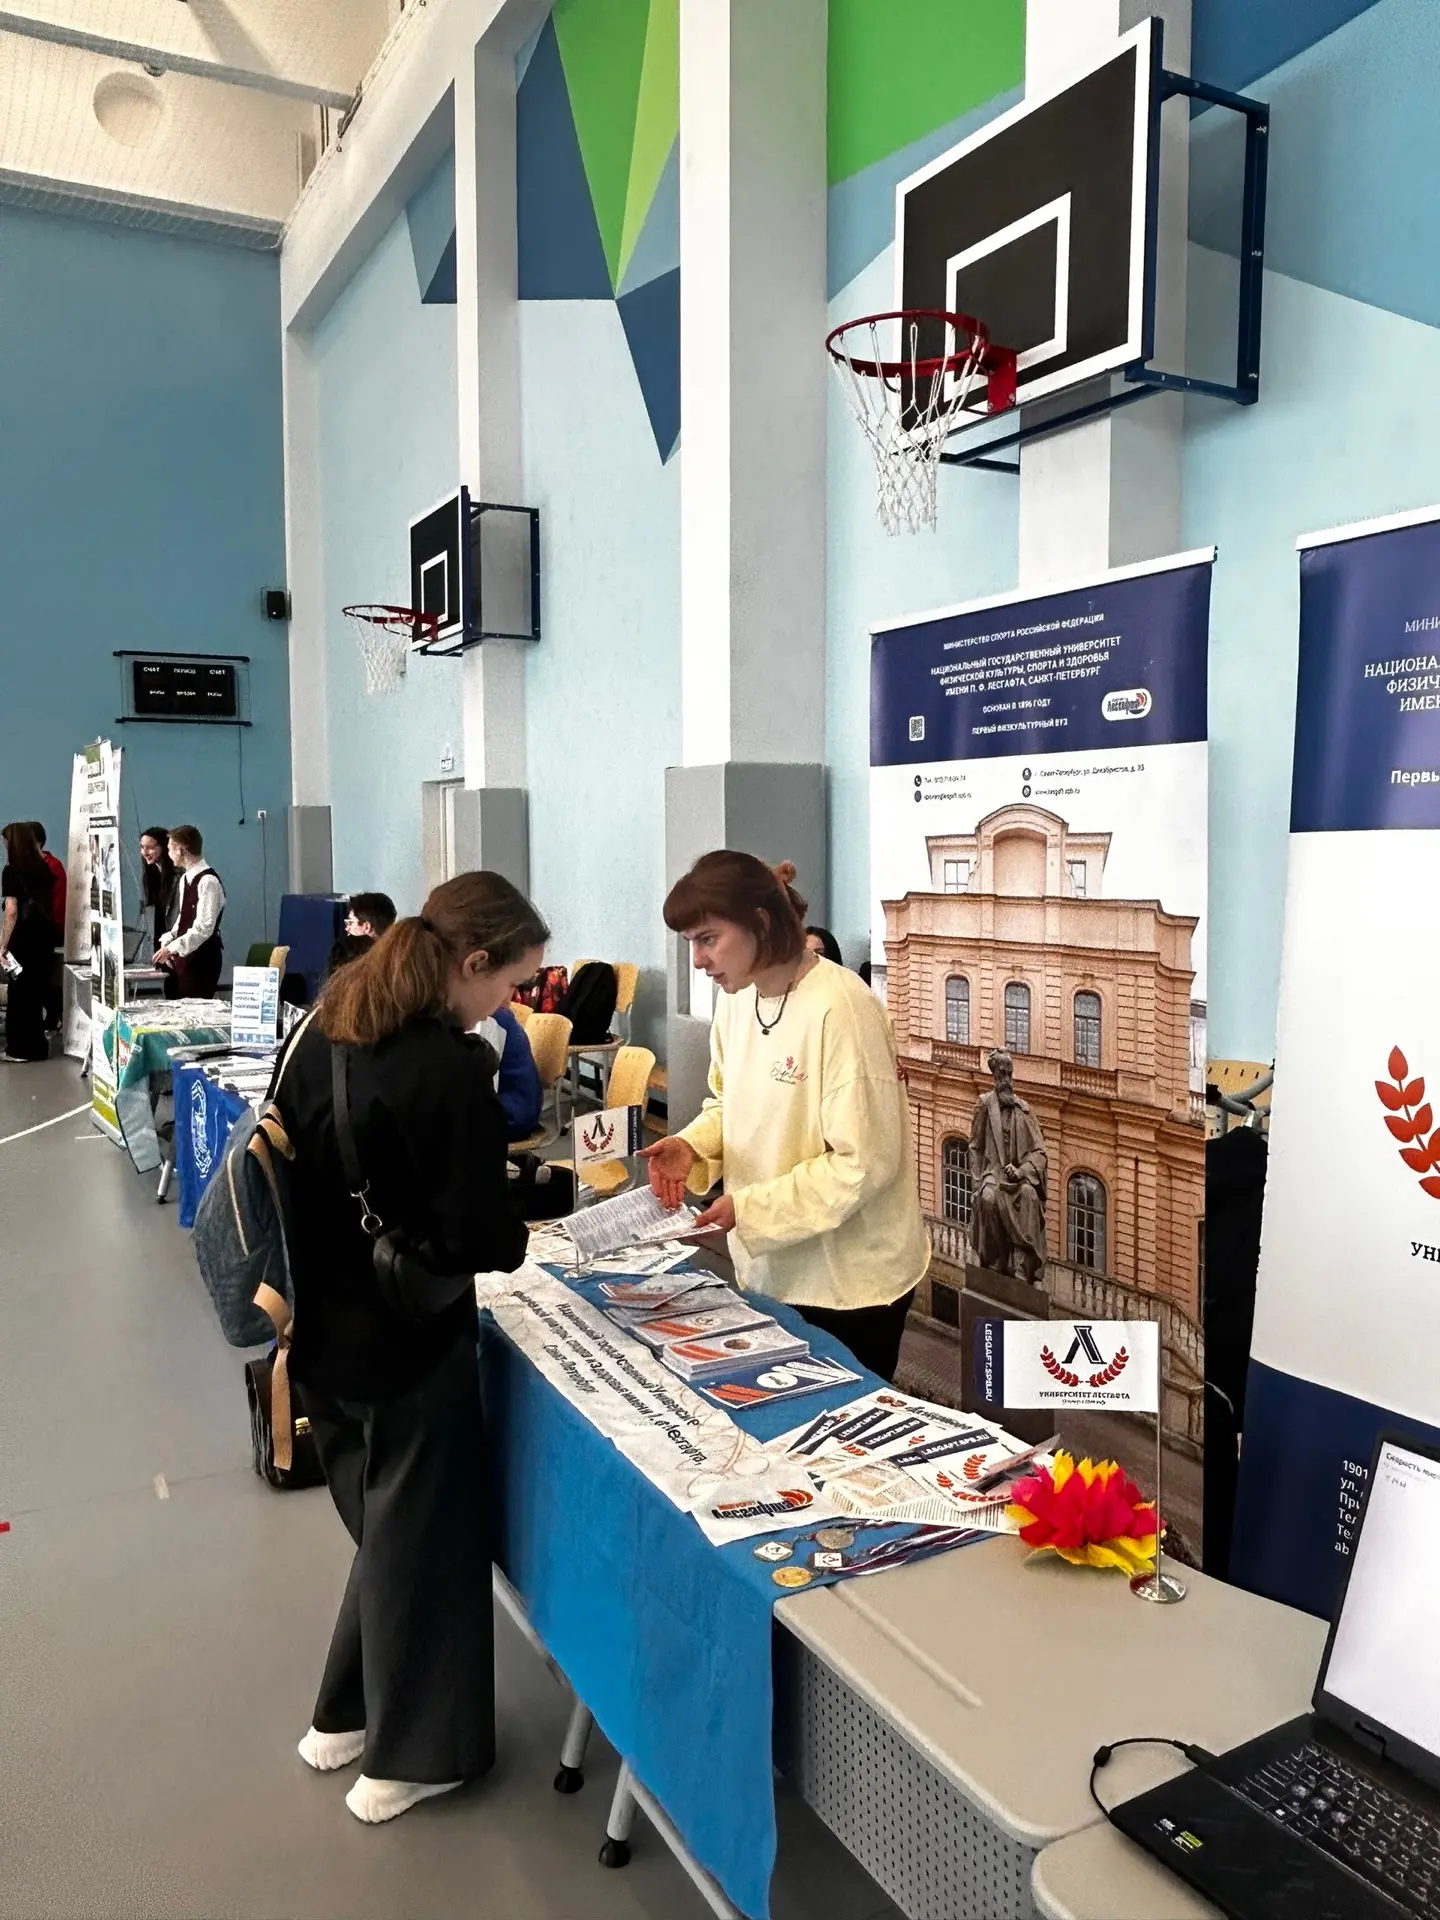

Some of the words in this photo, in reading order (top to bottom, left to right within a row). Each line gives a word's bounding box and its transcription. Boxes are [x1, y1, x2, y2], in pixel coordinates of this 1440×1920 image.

[991, 631, 1015, 642] СПОРТА
[1016, 620, 1060, 637] РОССИЙСКОЙ
[1061, 613, 1104, 629] ФЕДЕРАЦИИ
[931, 657, 987, 675] НАЦИОНАЛЬНЫЙ
[988, 644, 1062, 667] ГОСУДАРСТВЕННЫЙ
[1063, 636, 1121, 655] УНИВЕРСИТЕТ
[940, 671, 985, 686] ФИЗИЧЕСКОЙ
[986, 663, 1025, 679] КУЛЬТУРЫ,
[1027, 658, 1057, 673] СПОРТА
[1059, 658, 1065, 667] И
[1066, 652, 1110, 667] ЗДОРОВЬЯ
[1364, 655, 1440, 678] НАЦИОНА
[945, 685, 969, 696] ИМЕНИ
[1028, 666, 1101, 685] САНКТ-ПЕТЕРБУРГ
[1033, 698, 1051, 708] ГОДУ
